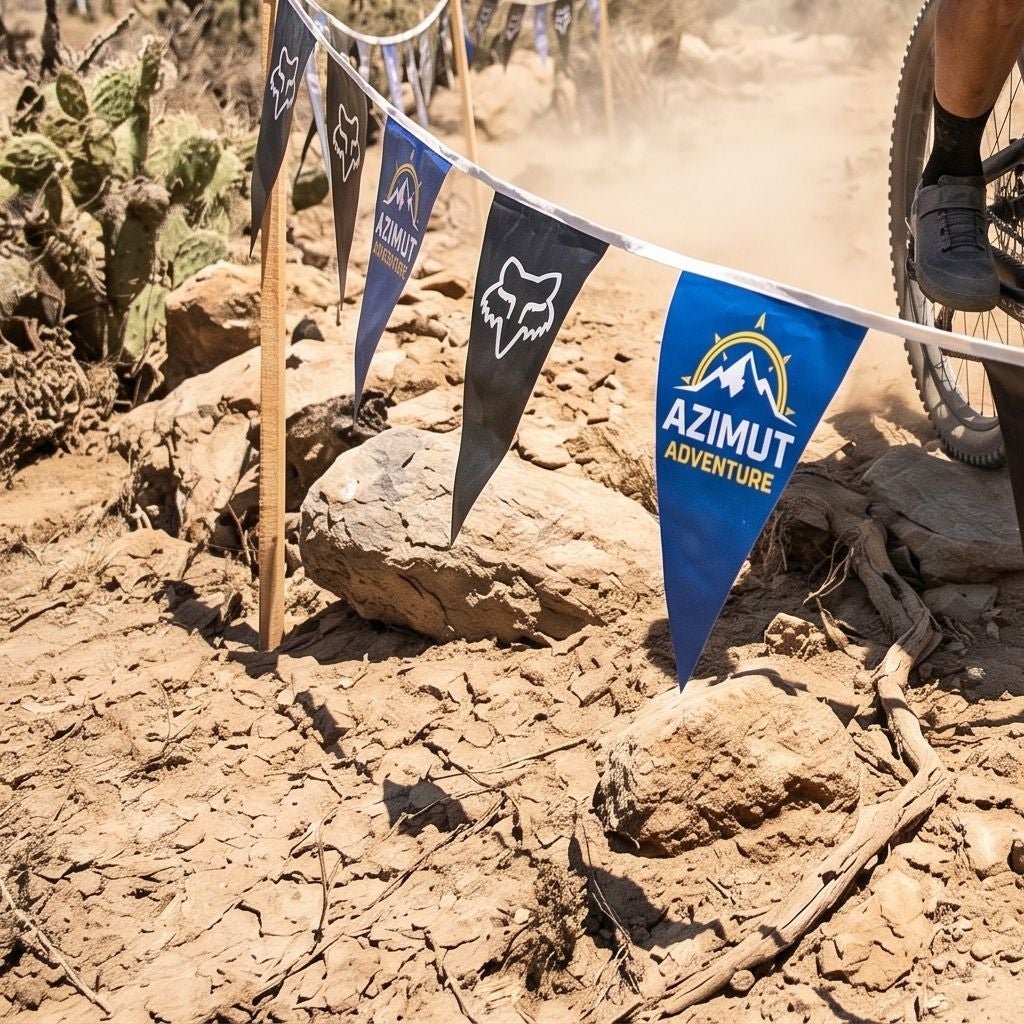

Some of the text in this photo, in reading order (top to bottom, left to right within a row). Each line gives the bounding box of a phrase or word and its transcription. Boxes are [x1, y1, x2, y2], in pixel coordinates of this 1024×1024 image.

[375, 212, 418, 262] AZIMUT
[661, 398, 795, 469] AZIMUT
[664, 440, 775, 494] ADVENTURE
